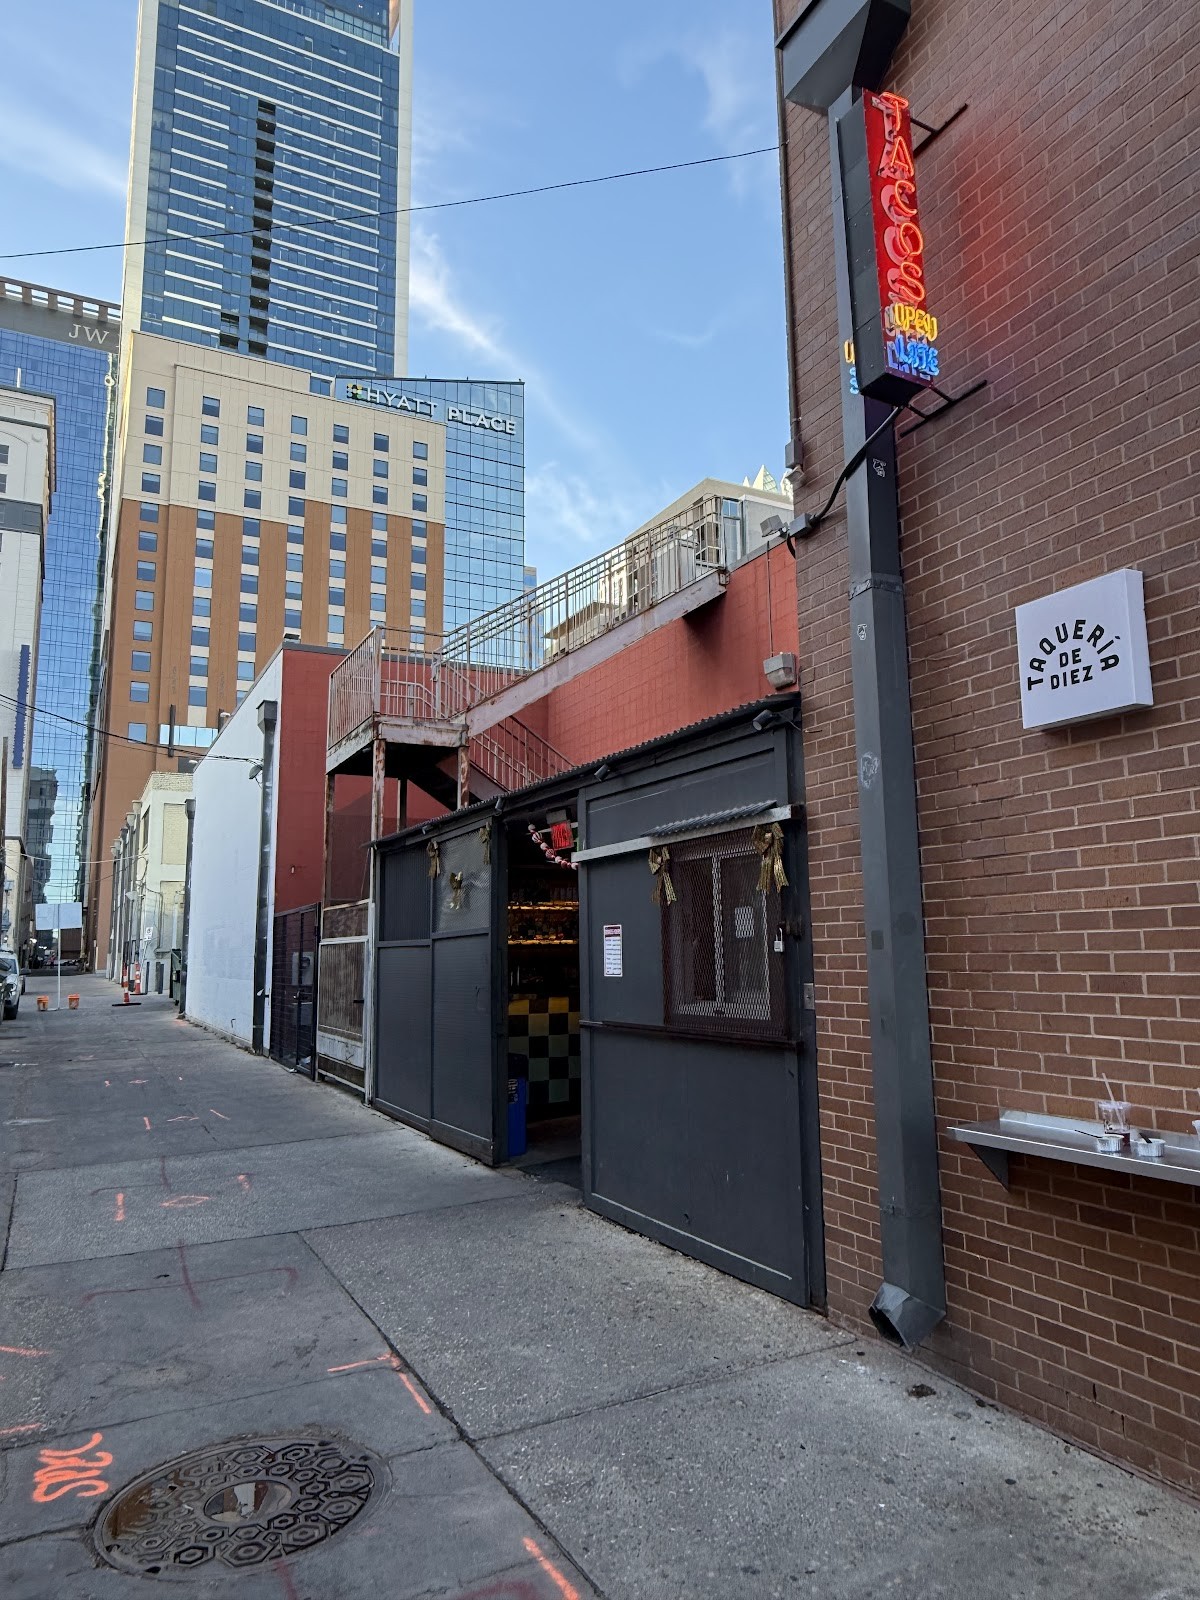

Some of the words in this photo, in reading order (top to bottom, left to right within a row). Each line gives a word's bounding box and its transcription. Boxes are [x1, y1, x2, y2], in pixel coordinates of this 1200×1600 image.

[871, 91, 925, 303] TACOS
[68, 323, 110, 345] JW
[886, 302, 938, 343] OPEN
[367, 387, 438, 417] HYATT
[448, 406, 517, 435] PLACE
[1027, 619, 1121, 691] TAQUERÍA
[1059, 647, 1082, 668] DE
[1050, 664, 1093, 690] DIEZ
